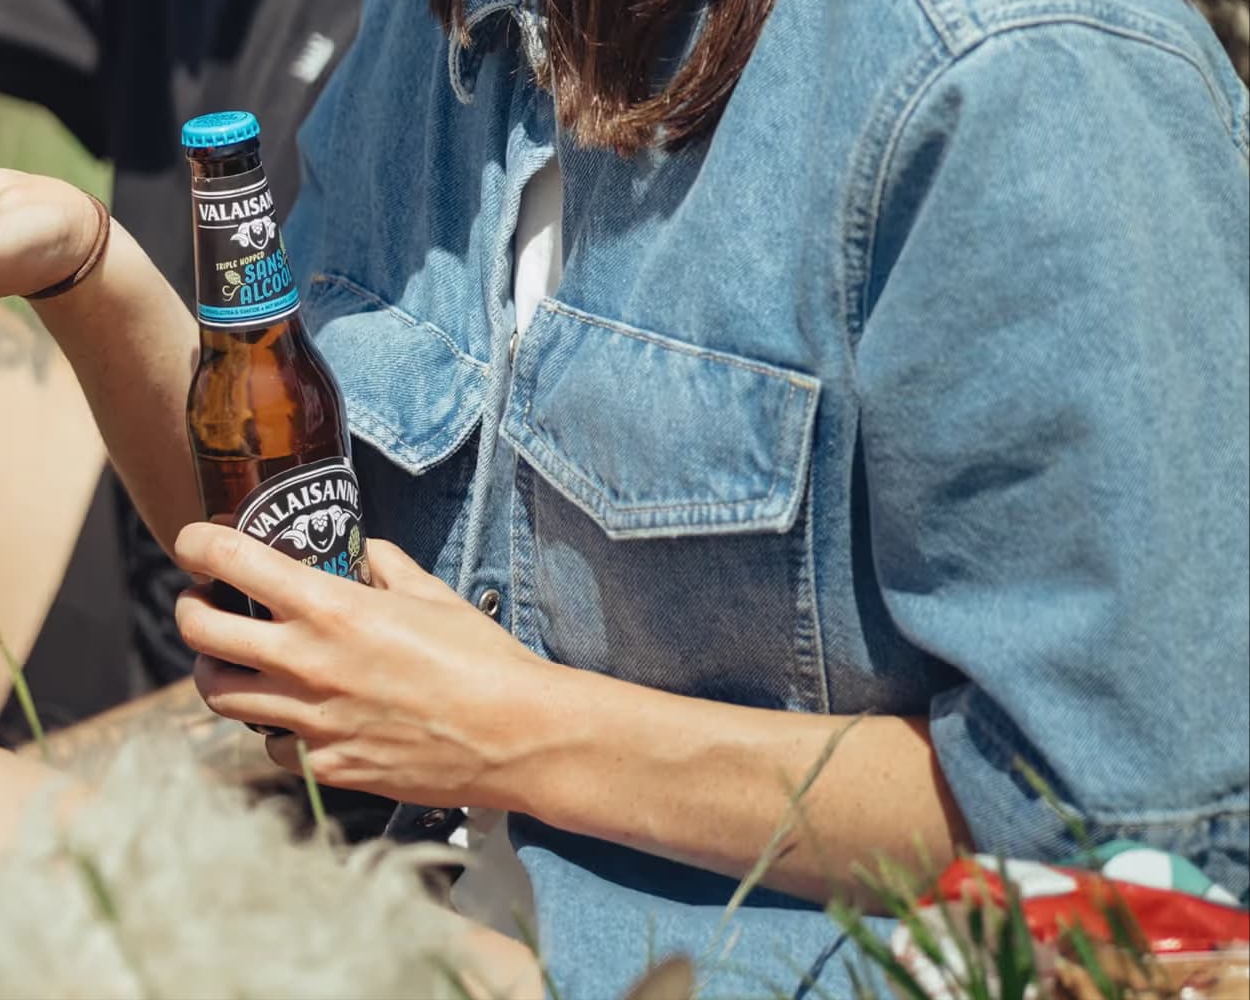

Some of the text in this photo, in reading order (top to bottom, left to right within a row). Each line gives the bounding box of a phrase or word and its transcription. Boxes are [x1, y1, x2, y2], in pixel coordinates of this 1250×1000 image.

[216, 250, 265, 271] TRIPLE HOPPED
[244, 248, 284, 284] SANS
[240, 263, 292, 305] ALCOOL
[248, 479, 358, 538] VALAISANNE
